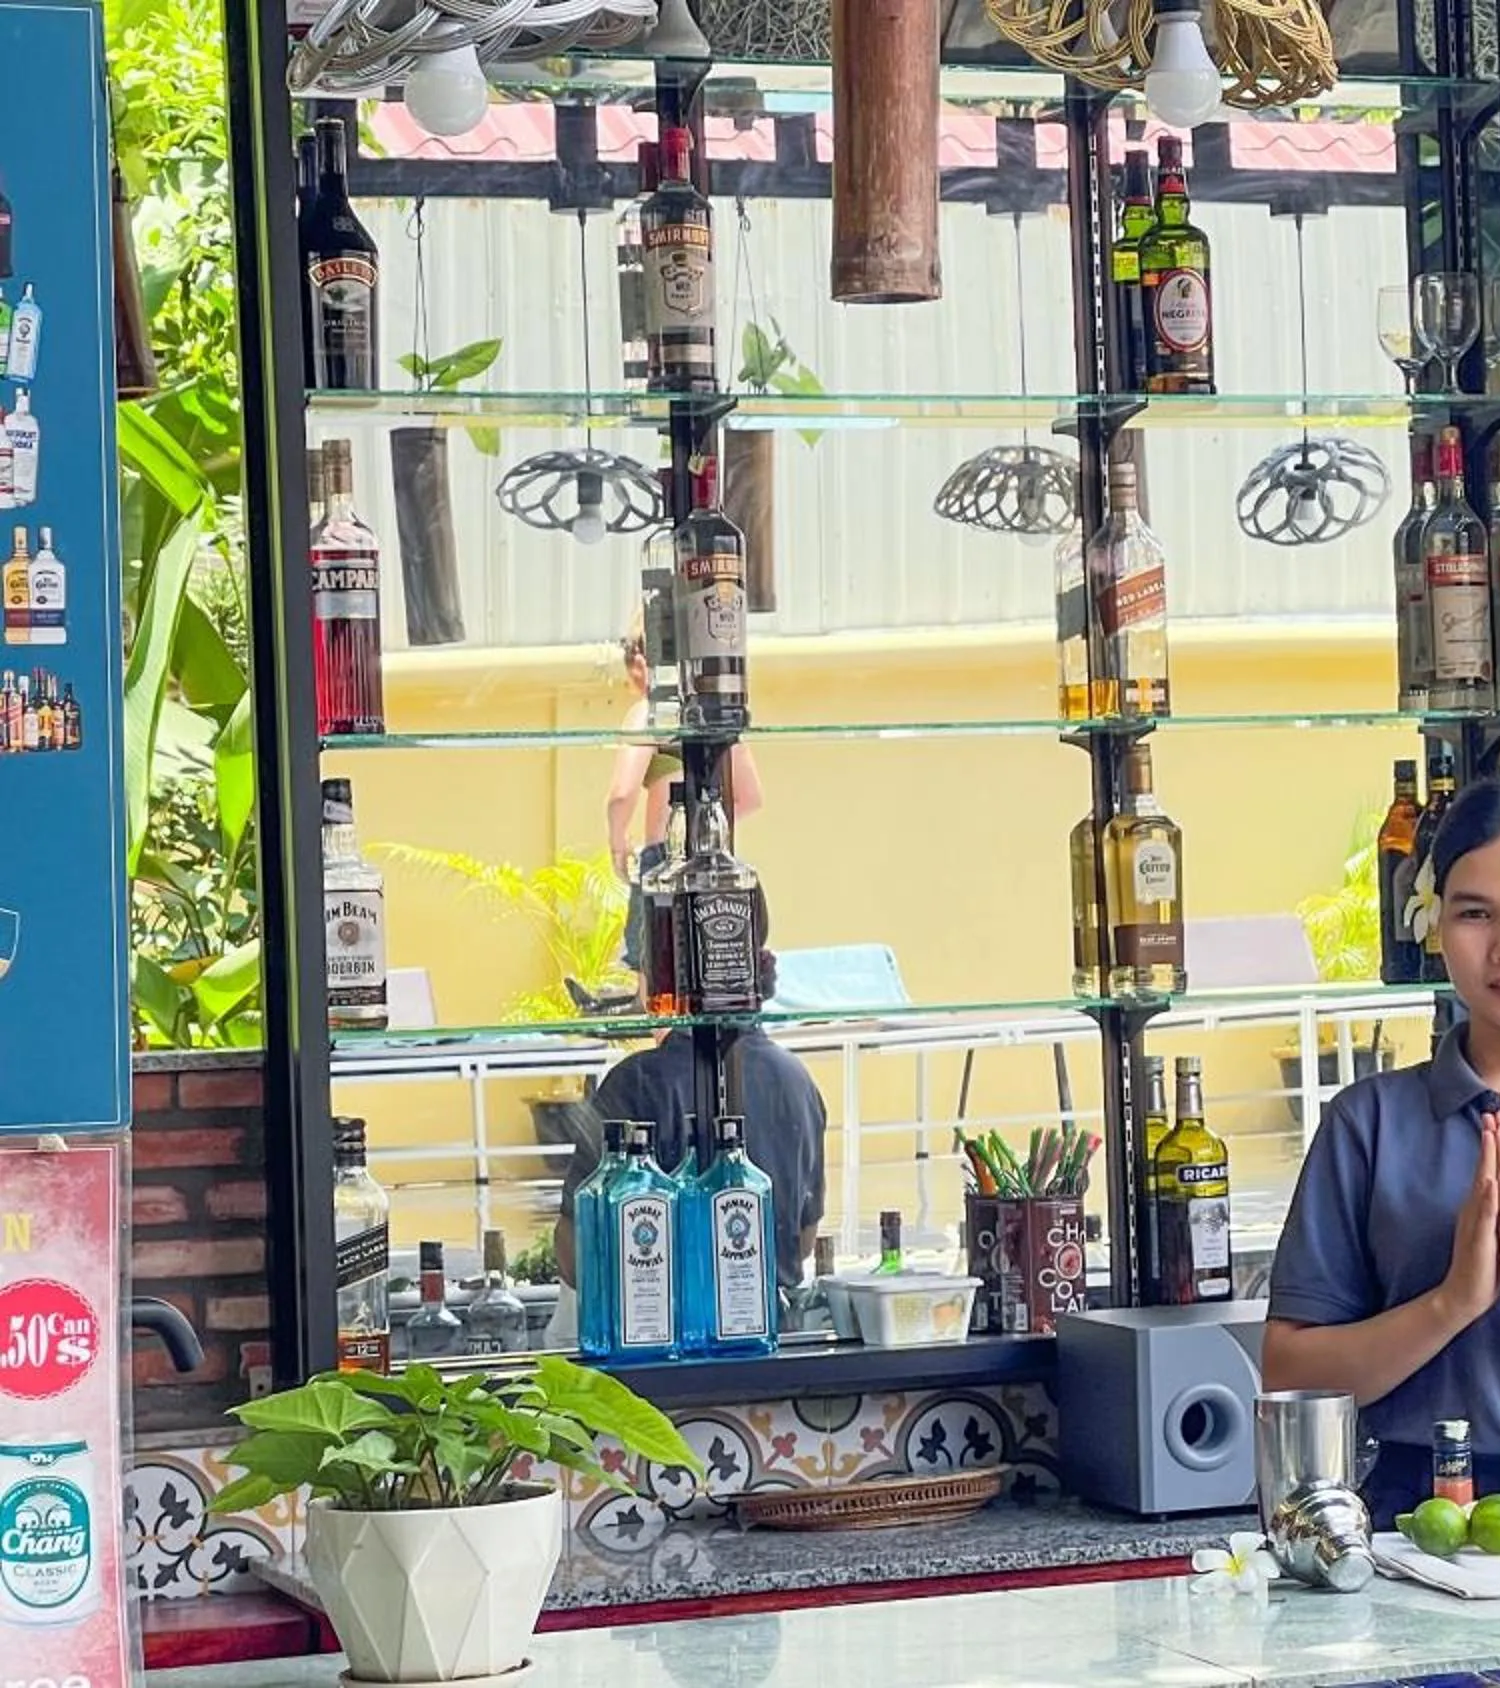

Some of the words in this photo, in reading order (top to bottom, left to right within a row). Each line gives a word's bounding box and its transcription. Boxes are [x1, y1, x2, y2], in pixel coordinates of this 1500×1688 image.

[325, 906, 341, 922] IM
[47, 1312, 91, 1336] Can
[1, 1526, 88, 1557] Chang
